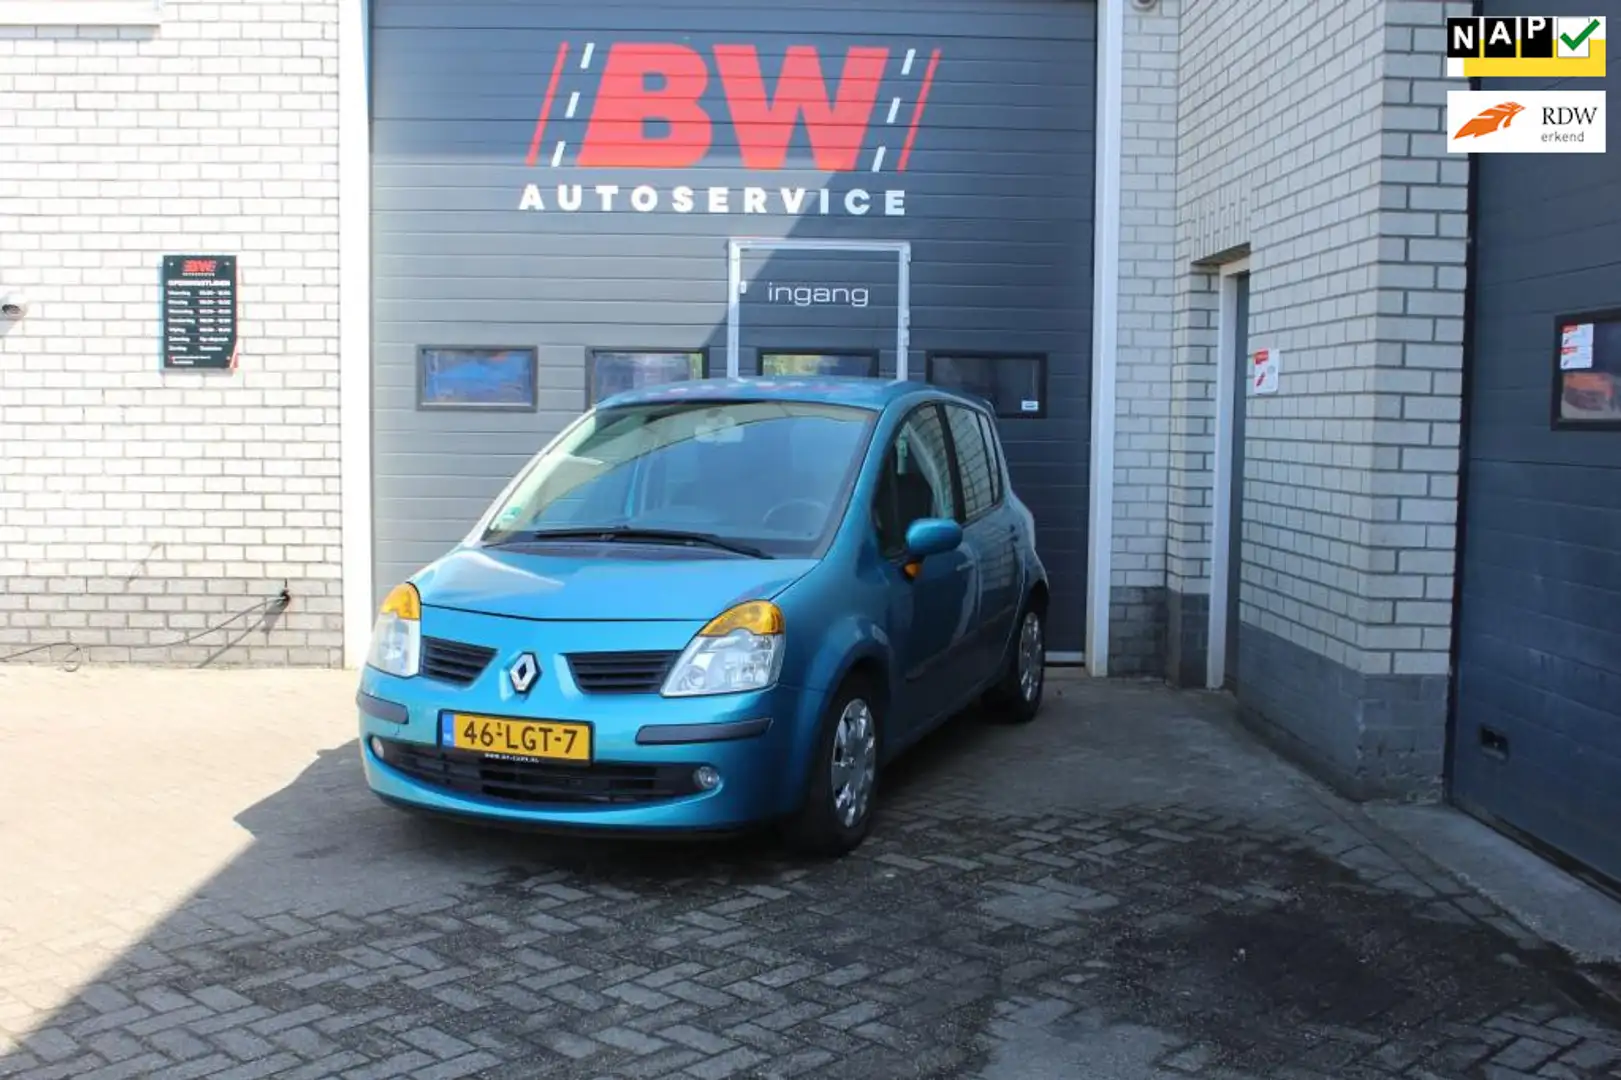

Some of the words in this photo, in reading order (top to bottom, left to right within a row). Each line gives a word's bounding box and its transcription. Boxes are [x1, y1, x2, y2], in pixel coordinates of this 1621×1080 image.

[577, 42, 890, 172] BW
[518, 183, 907, 217] AUTOSERVICE
[768, 281, 869, 307] ingang
[463, 720, 578, 755] 46-LGT-7
